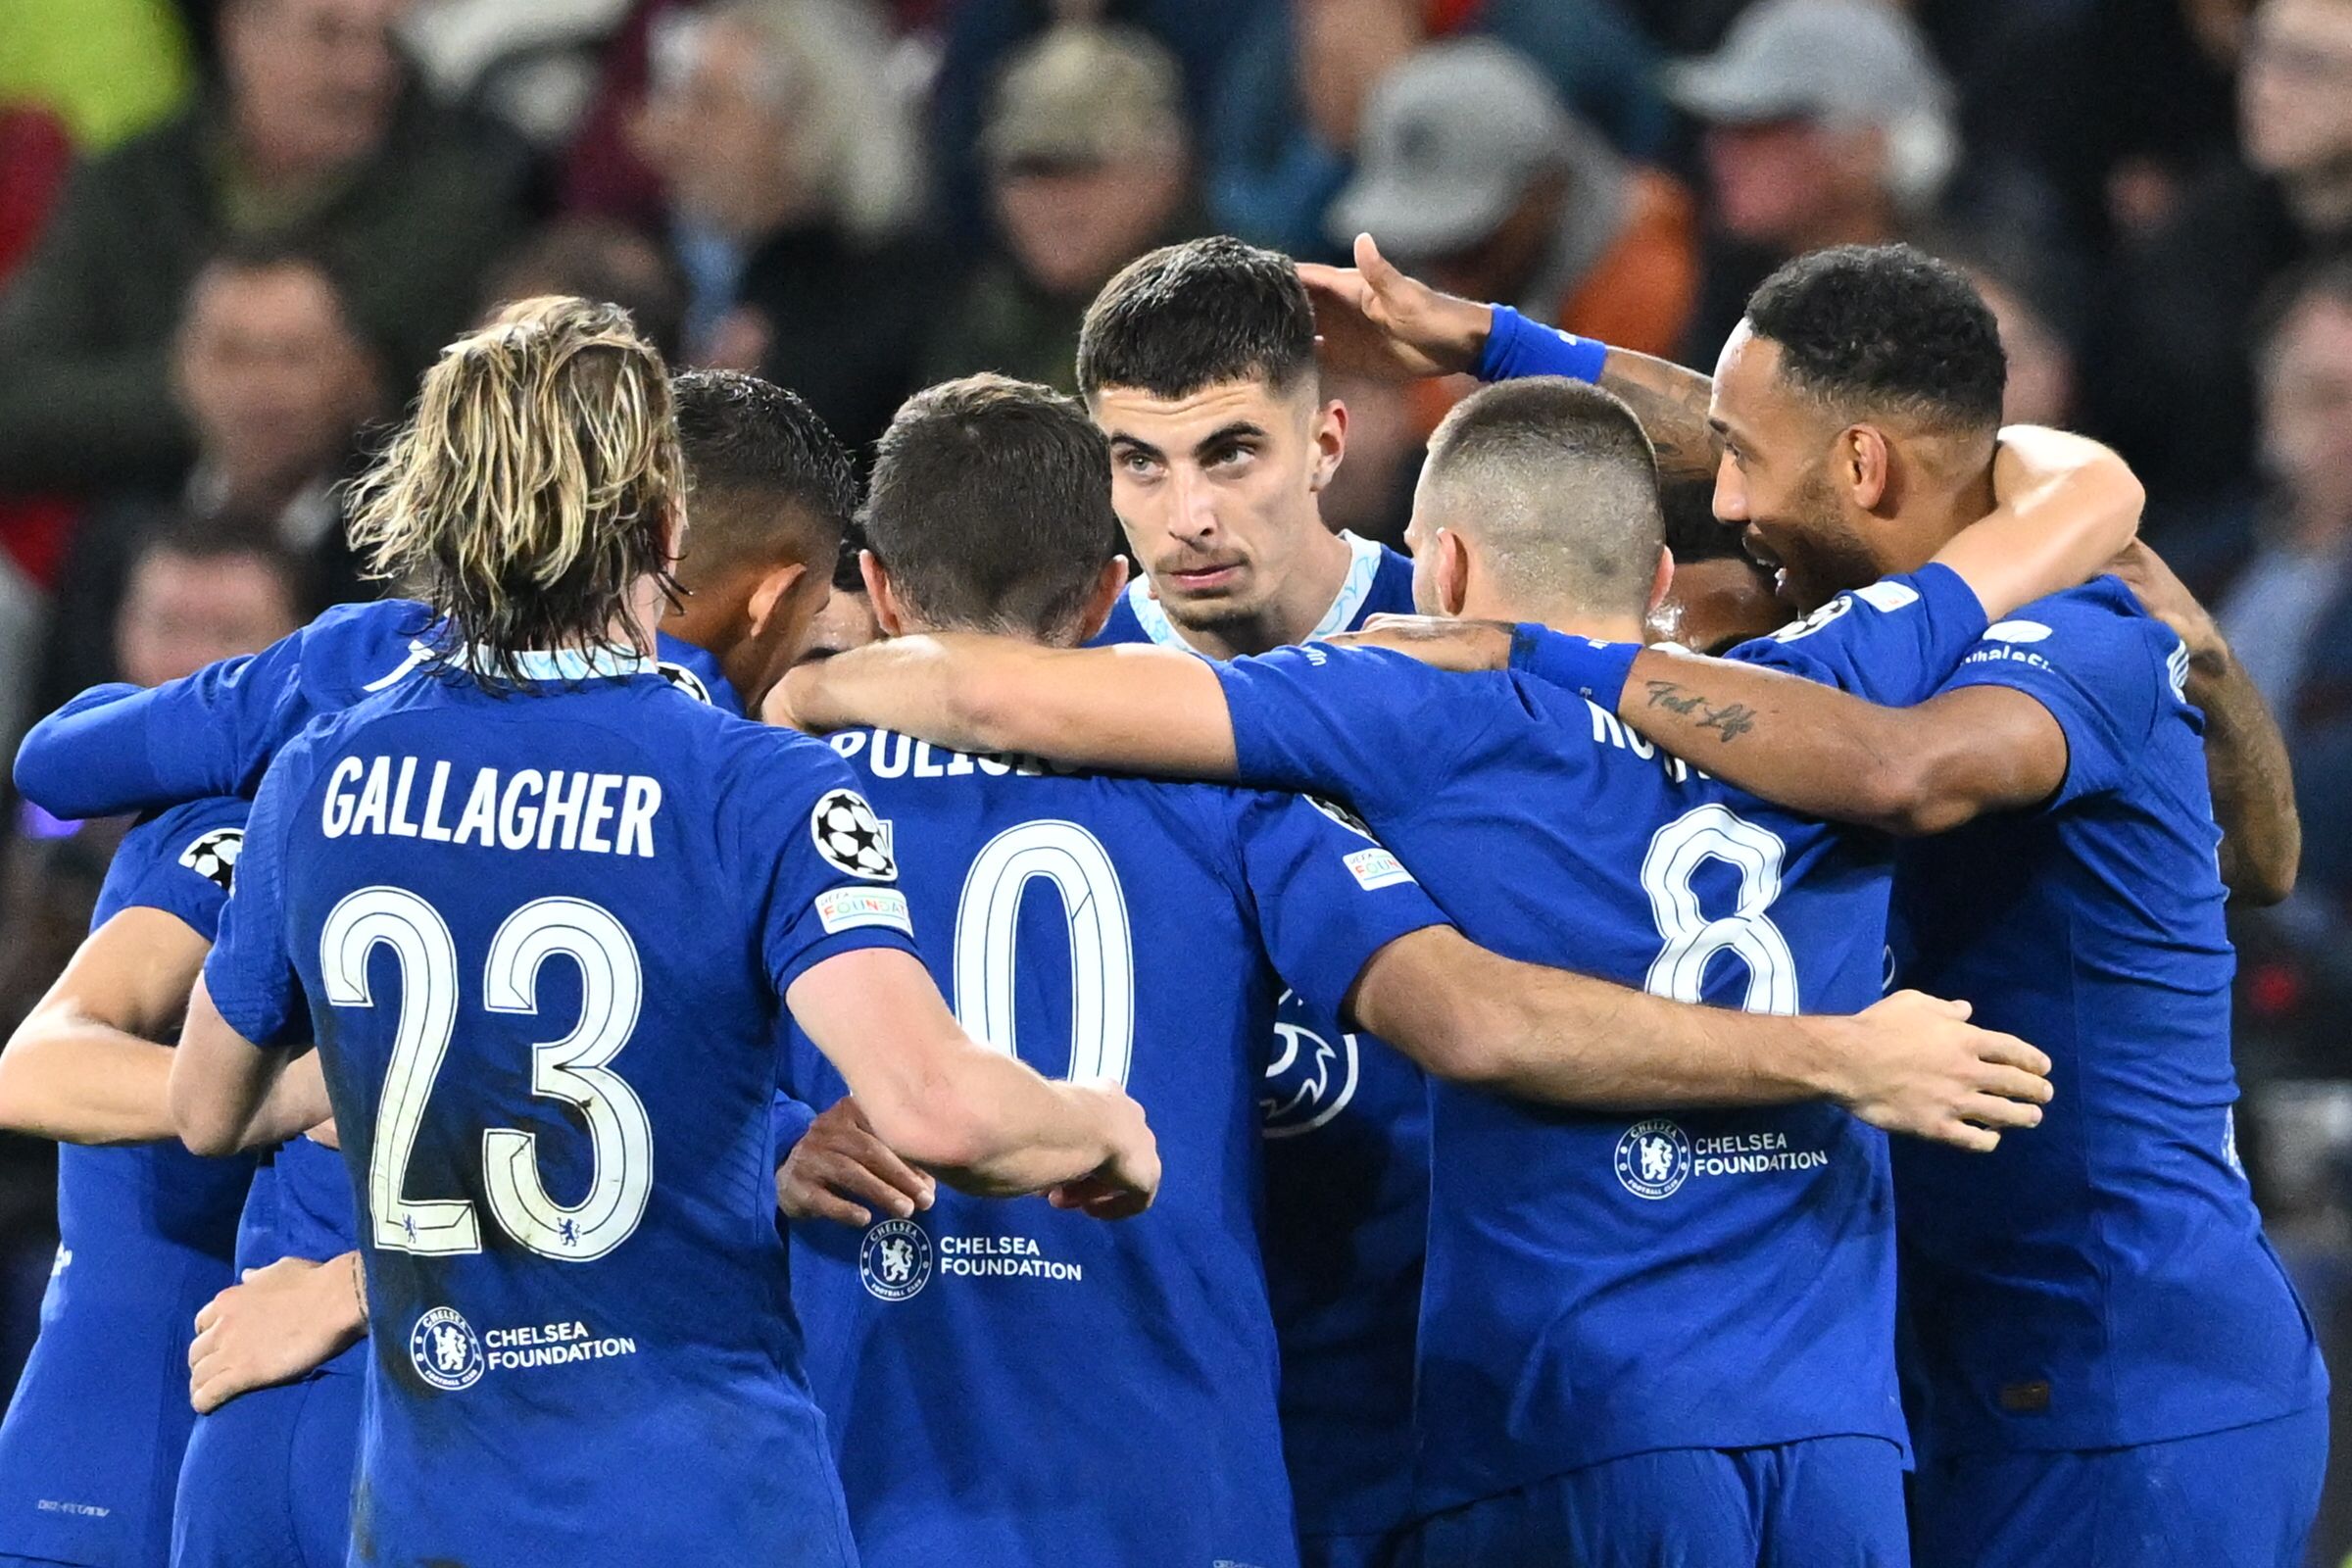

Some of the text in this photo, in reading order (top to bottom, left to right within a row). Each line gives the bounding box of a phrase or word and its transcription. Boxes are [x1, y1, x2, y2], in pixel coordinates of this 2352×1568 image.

[322, 756, 662, 858] GALLAGHER
[1641, 803, 1799, 1016] 8
[319, 885, 654, 1262] 23
[1694, 1133, 1788, 1155] CHELSEA
[1693, 1151, 1829, 1177] FOUNDATION
[869, 1222, 918, 1242] CHELSEA
[940, 1237, 1041, 1256] CHELSEA
[940, 1257, 1082, 1281] FOUNDATION
[422, 1309, 466, 1328] CHELSEA
[485, 1321, 589, 1348] CHELSEA
[487, 1337, 636, 1371] FOUNDATION
